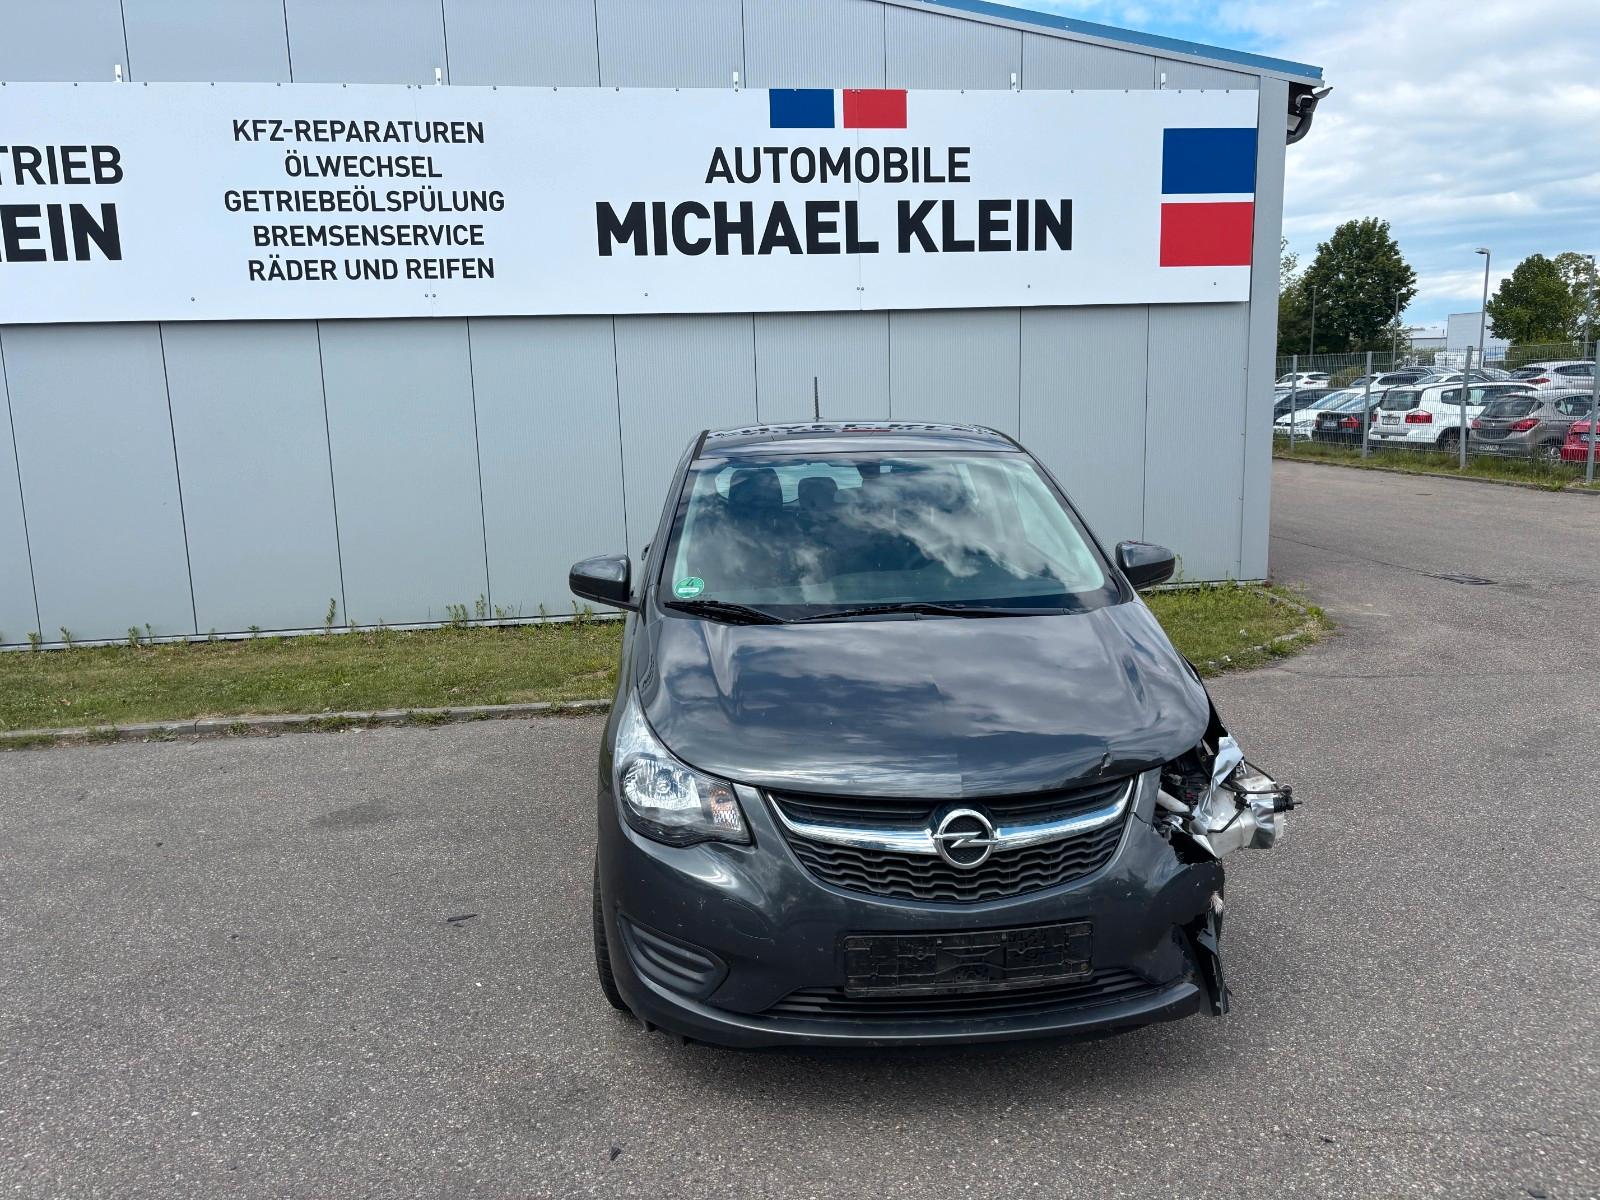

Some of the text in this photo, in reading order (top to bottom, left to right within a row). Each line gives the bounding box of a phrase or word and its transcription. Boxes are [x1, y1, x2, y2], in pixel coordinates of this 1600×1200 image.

[233, 119, 485, 144] KFZ-REPARATUREN
[284, 149, 443, 178] ÖLWECHSEL
[704, 146, 971, 184] AUTOMOBILE
[224, 184, 505, 213] GETRIEBEÖLSPÜLUNG
[0, 202, 123, 263] EIN
[253, 224, 485, 247] BREMSENSERVICE
[595, 198, 1073, 257] MICHAEL KLEIN
[248, 254, 495, 281] RÄDER UND REIFEN
